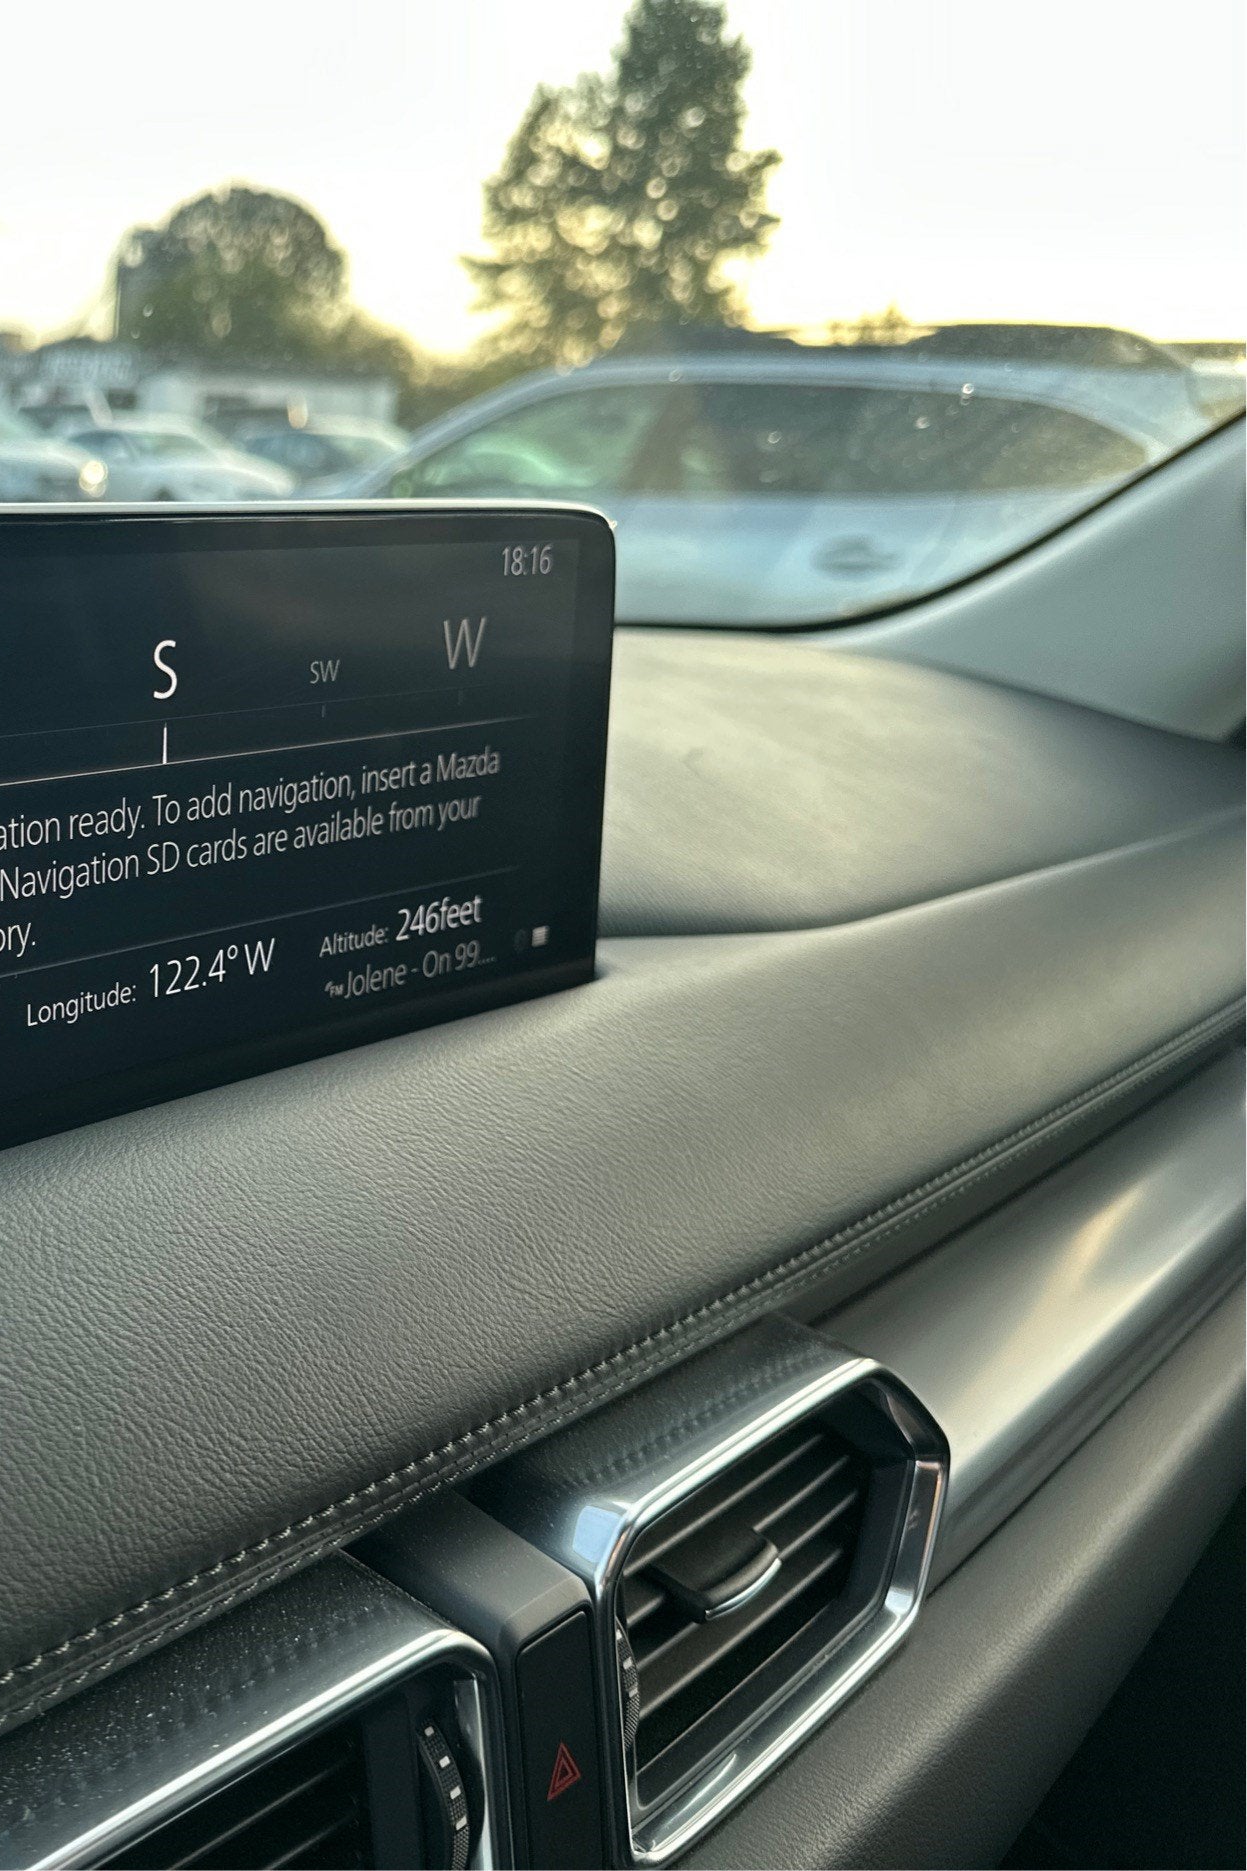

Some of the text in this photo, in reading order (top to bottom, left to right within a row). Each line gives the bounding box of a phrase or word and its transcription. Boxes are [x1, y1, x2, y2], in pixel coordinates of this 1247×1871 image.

[502, 544, 552, 576] 18:16
[153, 639, 178, 699] S
[310, 659, 340, 684] SW
[443, 616, 487, 670] W
[68, 797, 146, 840] ready.
[152, 793, 181, 826] To
[186, 782, 232, 822] add
[239, 771, 355, 814] navigation,
[361, 760, 416, 795] insert
[419, 762, 432, 785] a
[437, 745, 500, 782] Mazda
[0, 852, 139, 900] Navigation
[147, 841, 180, 876] SD
[186, 828, 248, 868] cards
[252, 829, 288, 856] are
[293, 805, 384, 850] available
[388, 800, 434, 834] from
[437, 794, 482, 832] your
[319, 895, 482, 958] Altitude: 246feet
[26, 937, 276, 1027] Longitude: 122.4° W
[344, 963, 407, 999] Jolene
[422, 950, 451, 979] On
